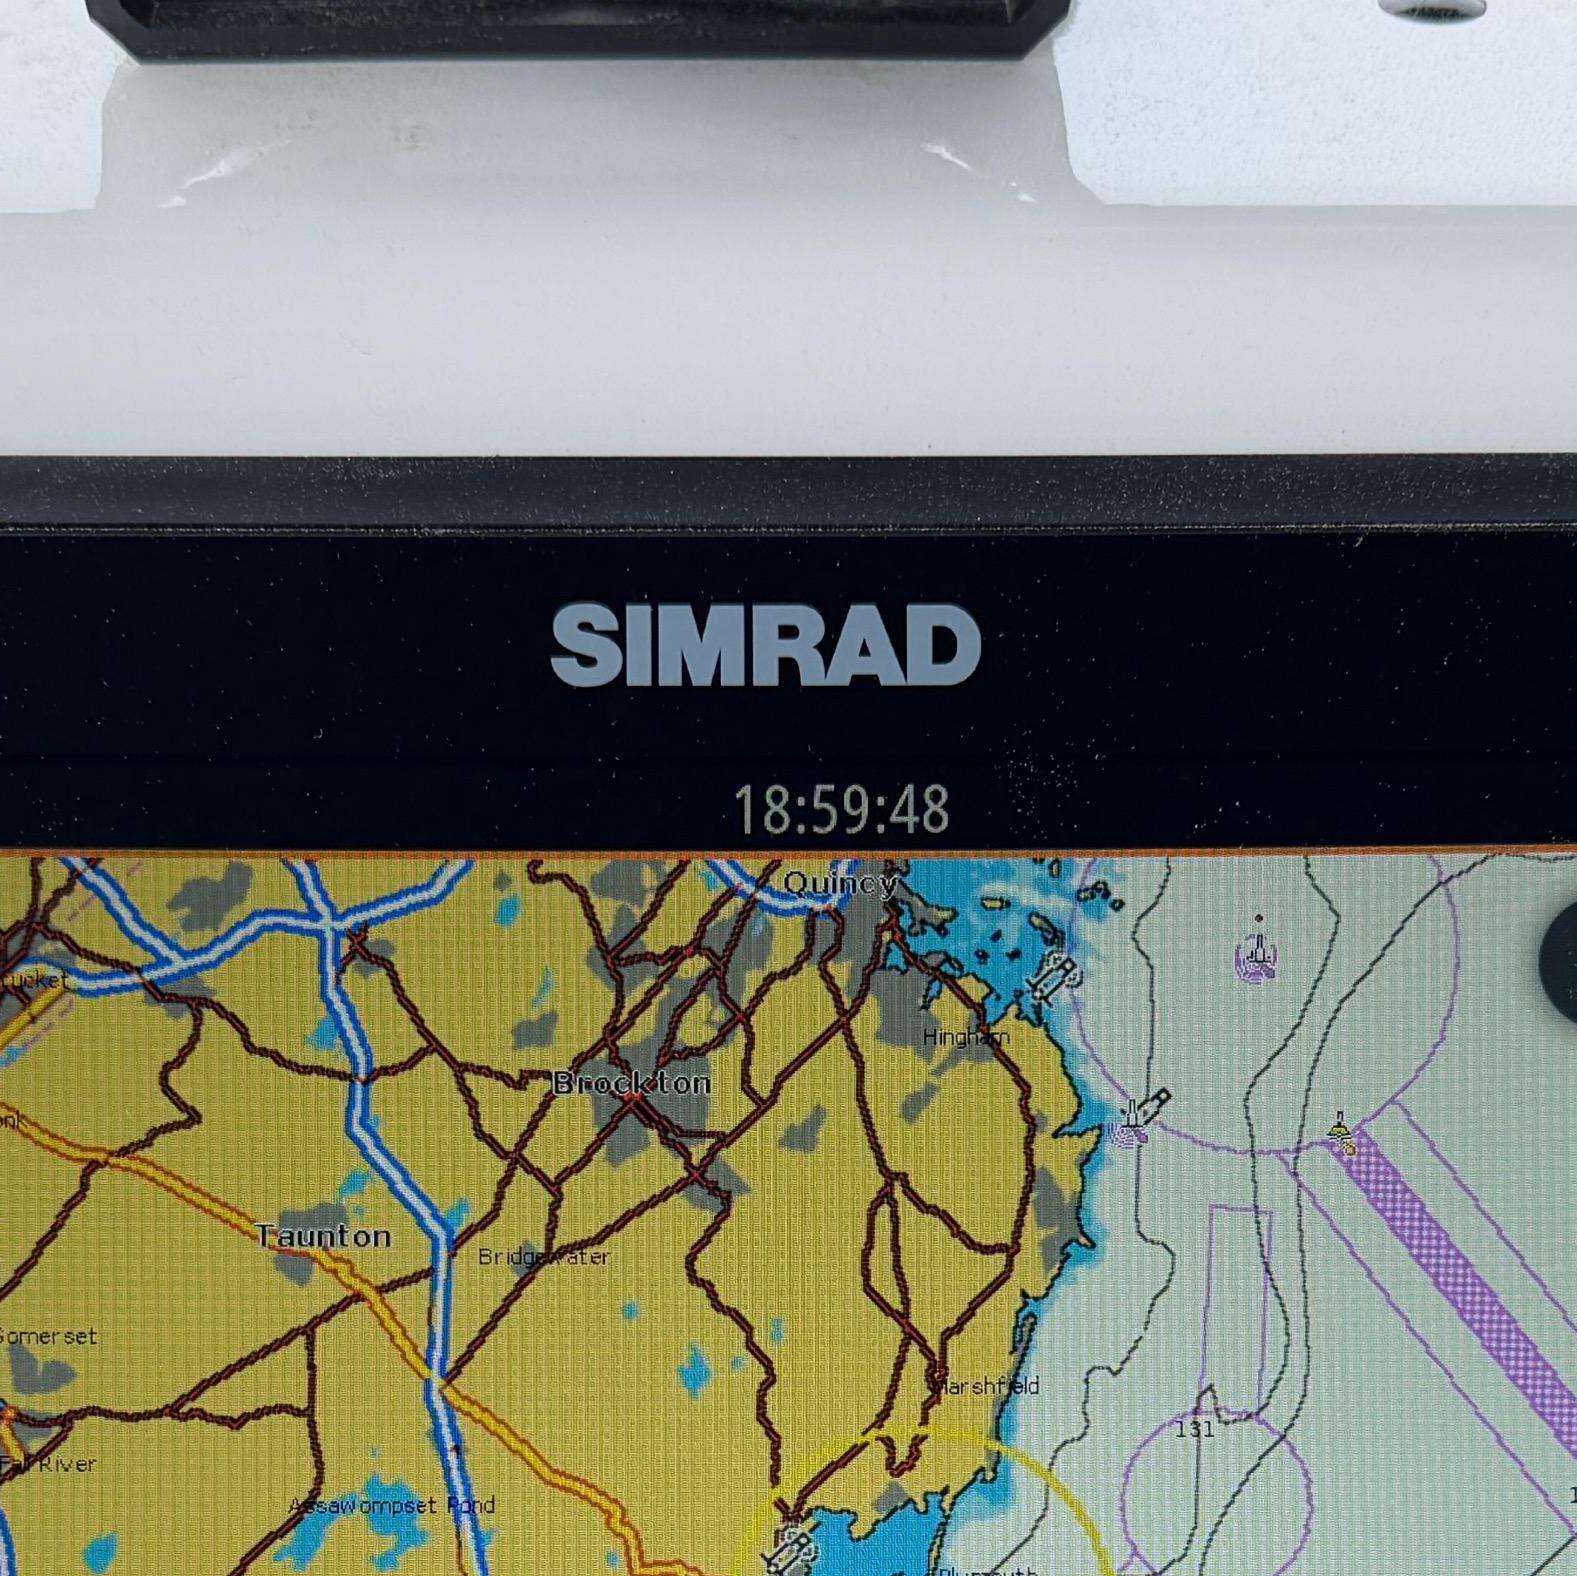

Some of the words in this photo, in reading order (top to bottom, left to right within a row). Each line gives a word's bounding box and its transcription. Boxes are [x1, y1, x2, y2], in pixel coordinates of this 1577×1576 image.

[550, 602, 982, 687] SIMRAD
[735, 783, 950, 834] 18:59:48
[783, 870, 898, 899] Quincy
[552, 1070, 713, 1097] Brockton
[254, 1222, 392, 1250] Taunton
[479, 1245, 611, 1269] Bridgeater
[1174, 1420, 1215, 1439] 131
[39, 1455, 98, 1473] River
[447, 1494, 496, 1515] Pond
